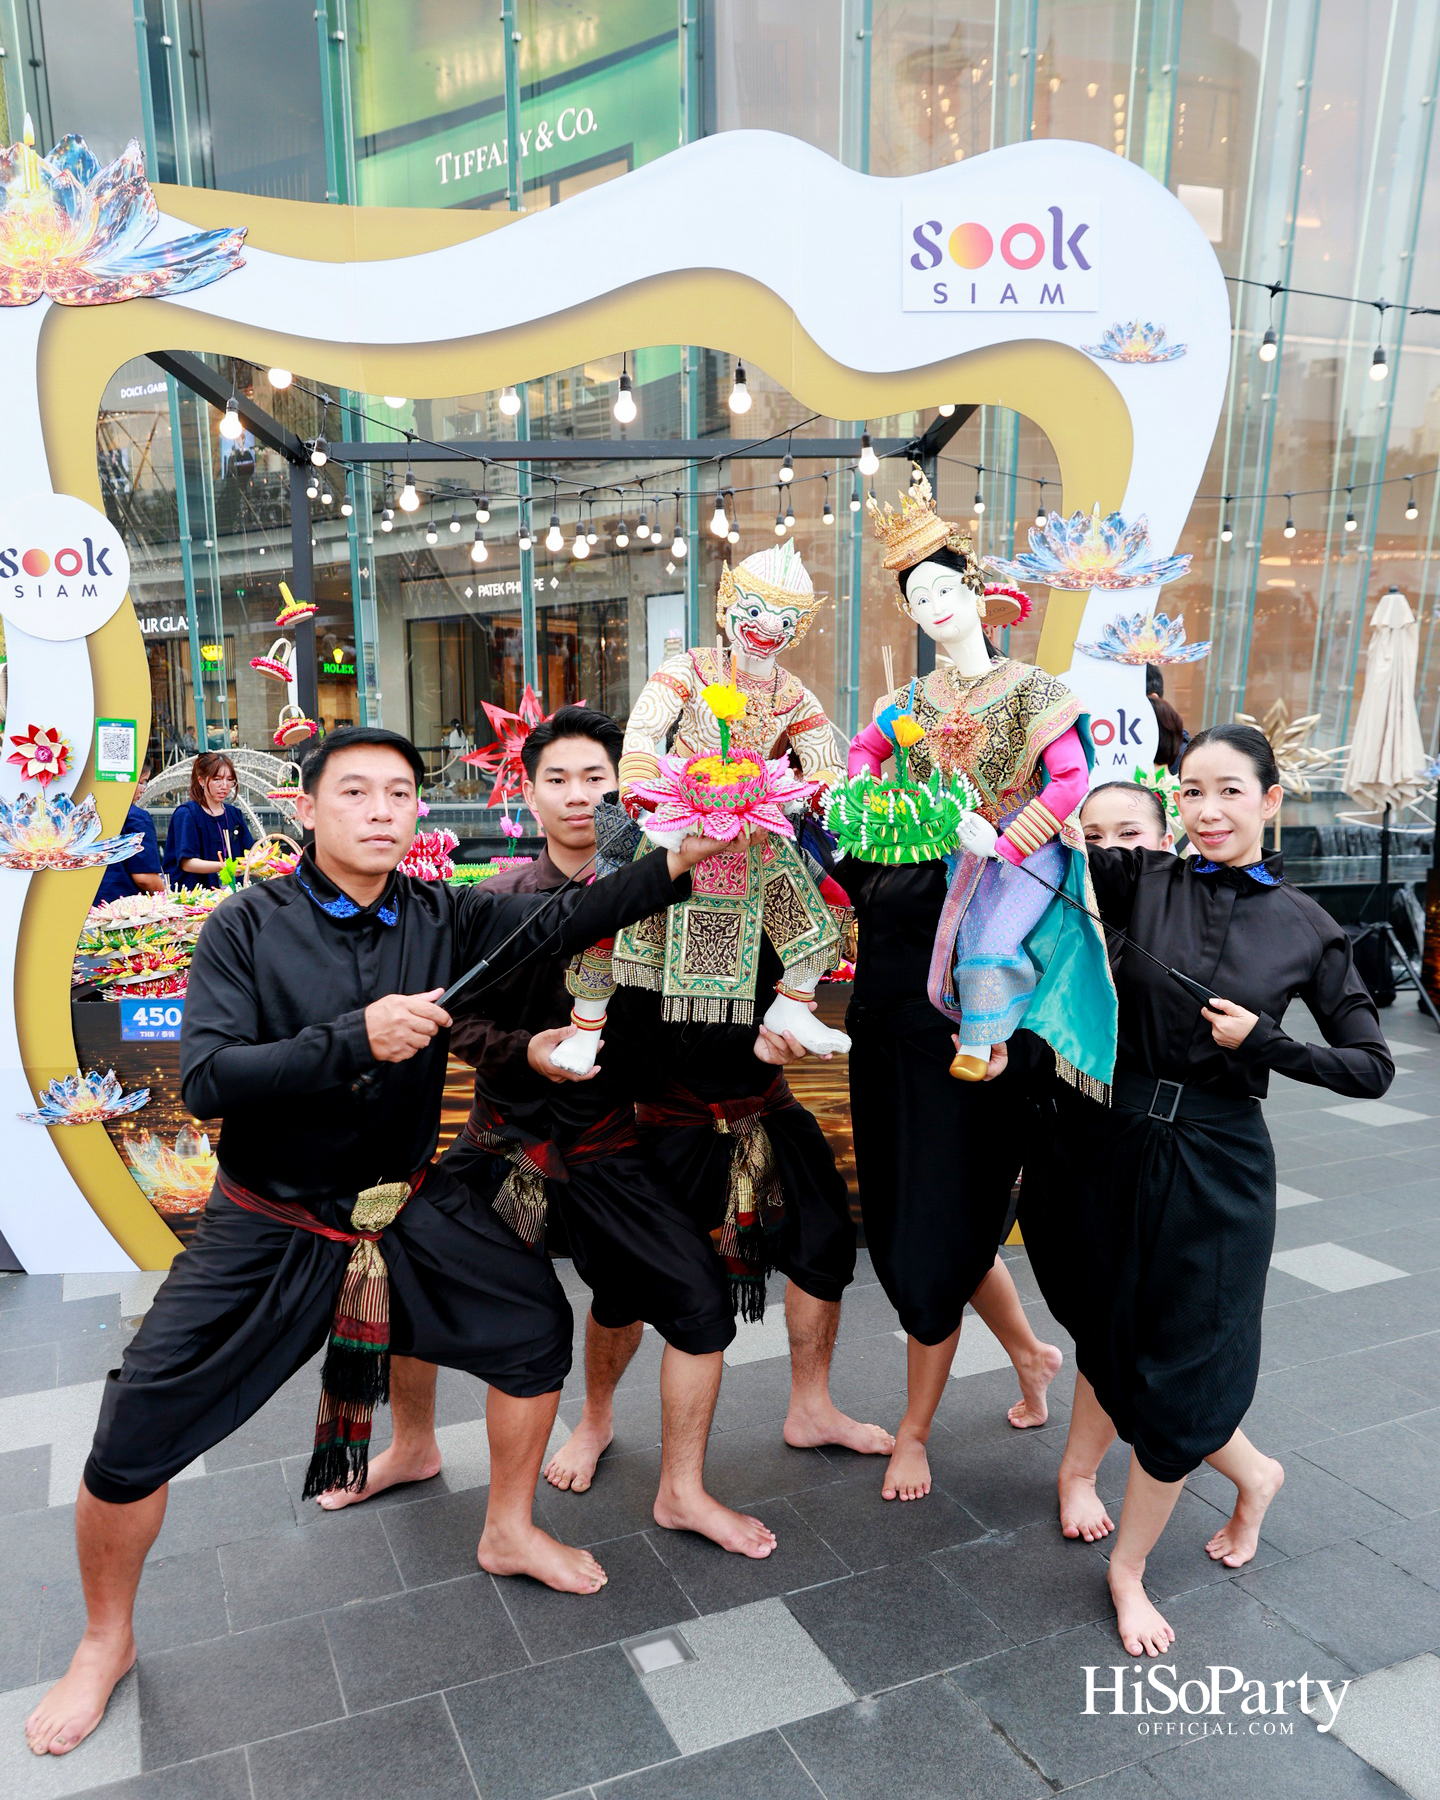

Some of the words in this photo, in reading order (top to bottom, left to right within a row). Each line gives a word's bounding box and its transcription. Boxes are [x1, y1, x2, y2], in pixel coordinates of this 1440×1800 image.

[535, 120, 554, 151] &
[933, 282, 1065, 304] SIAM
[14, 584, 98, 599] SIAM
[478, 582, 505, 597] PATEK
[323, 662, 355, 675] ROLEX
[133, 1006, 182, 1026] 450
